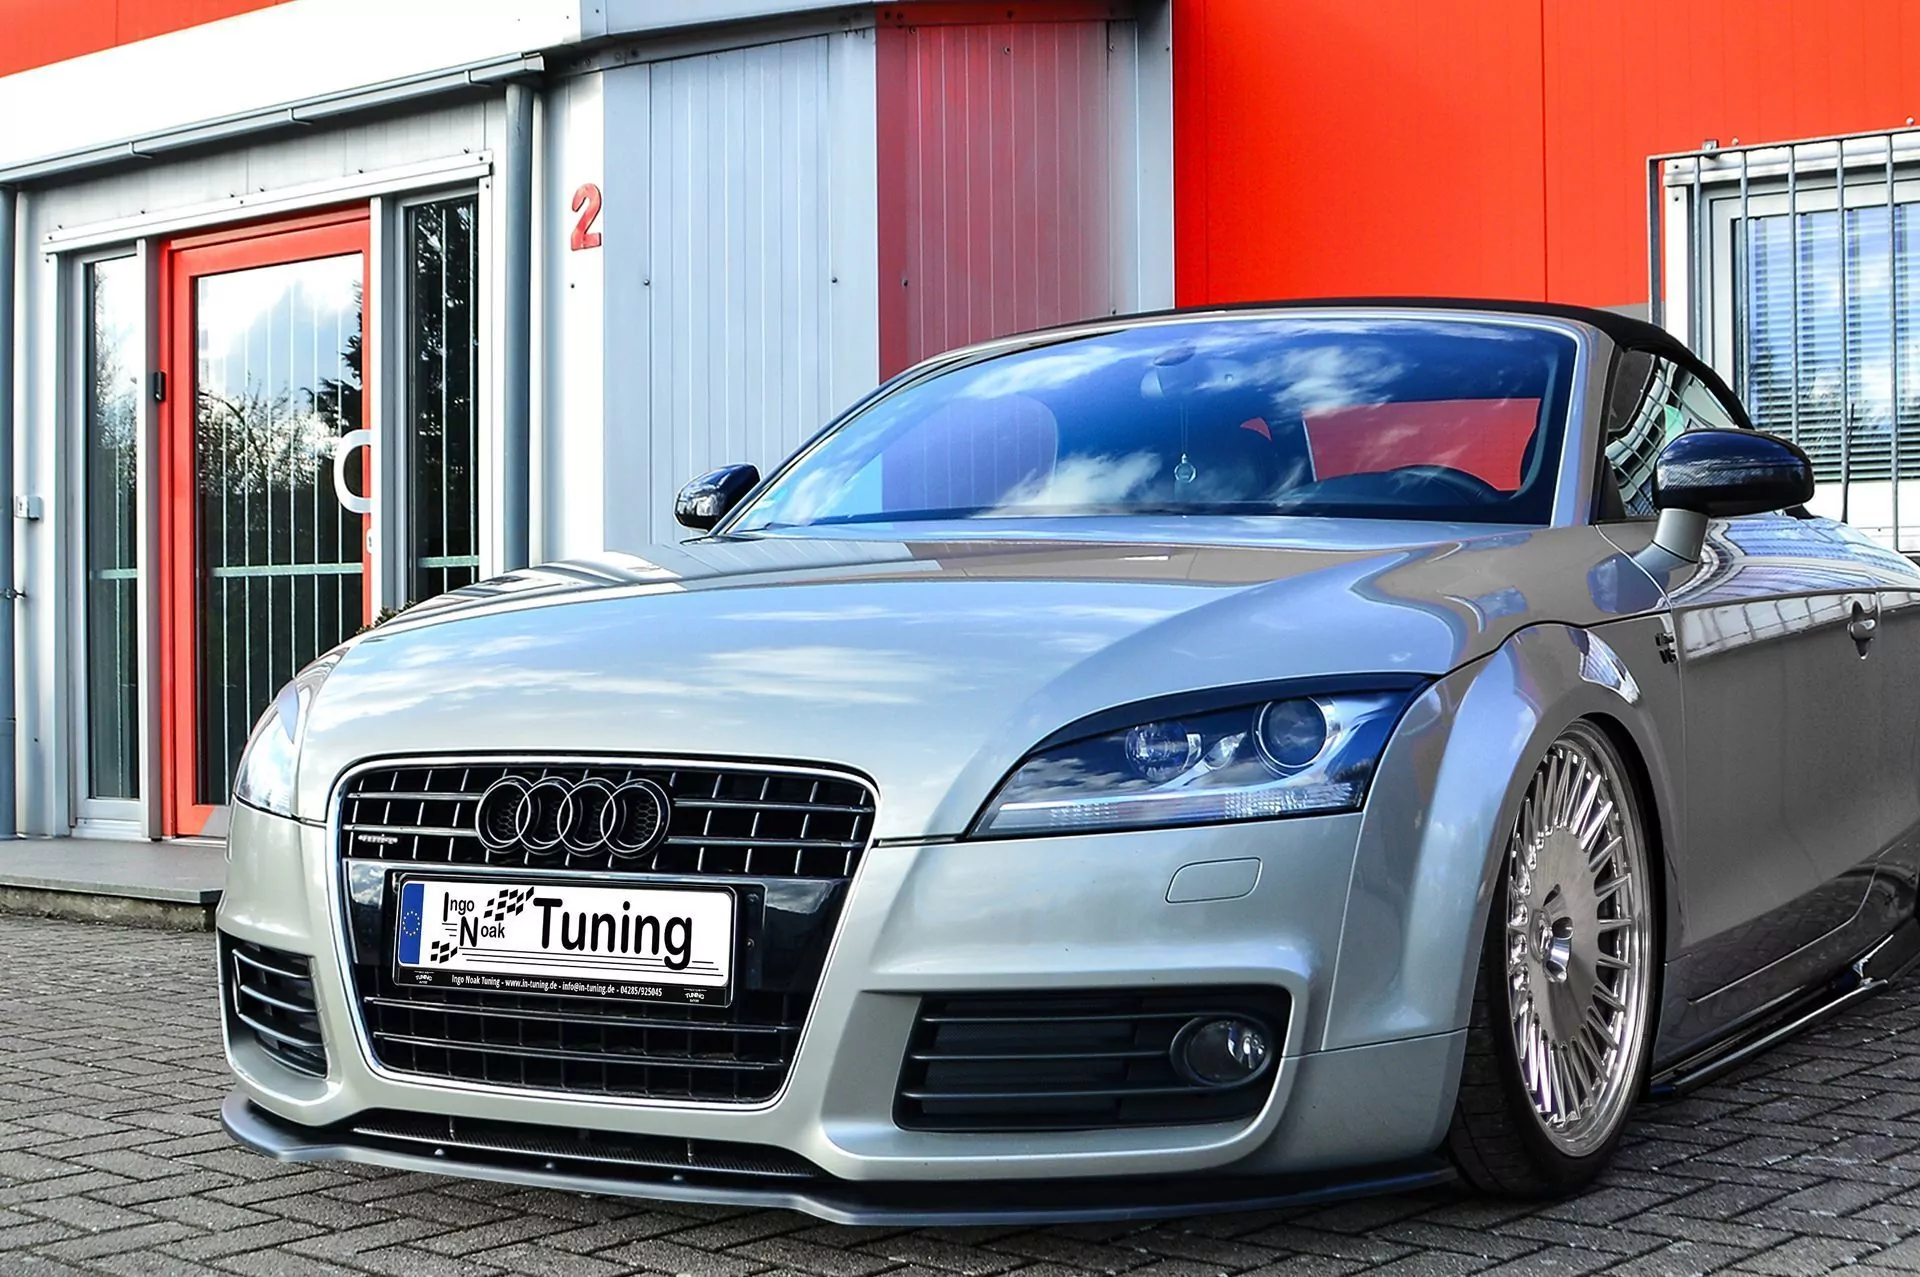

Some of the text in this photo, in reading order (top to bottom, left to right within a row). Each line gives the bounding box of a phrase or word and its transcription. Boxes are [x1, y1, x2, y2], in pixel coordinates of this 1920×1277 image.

[571, 183, 602, 251] 2
[443, 892, 474, 922] Ingo
[460, 916, 505, 947] Noak
[533, 897, 692, 970] Tuning
[451, 975, 663, 997] Ingo Noak Tuning www.in-tuning.de info@in-tuning.de 04285/925045
